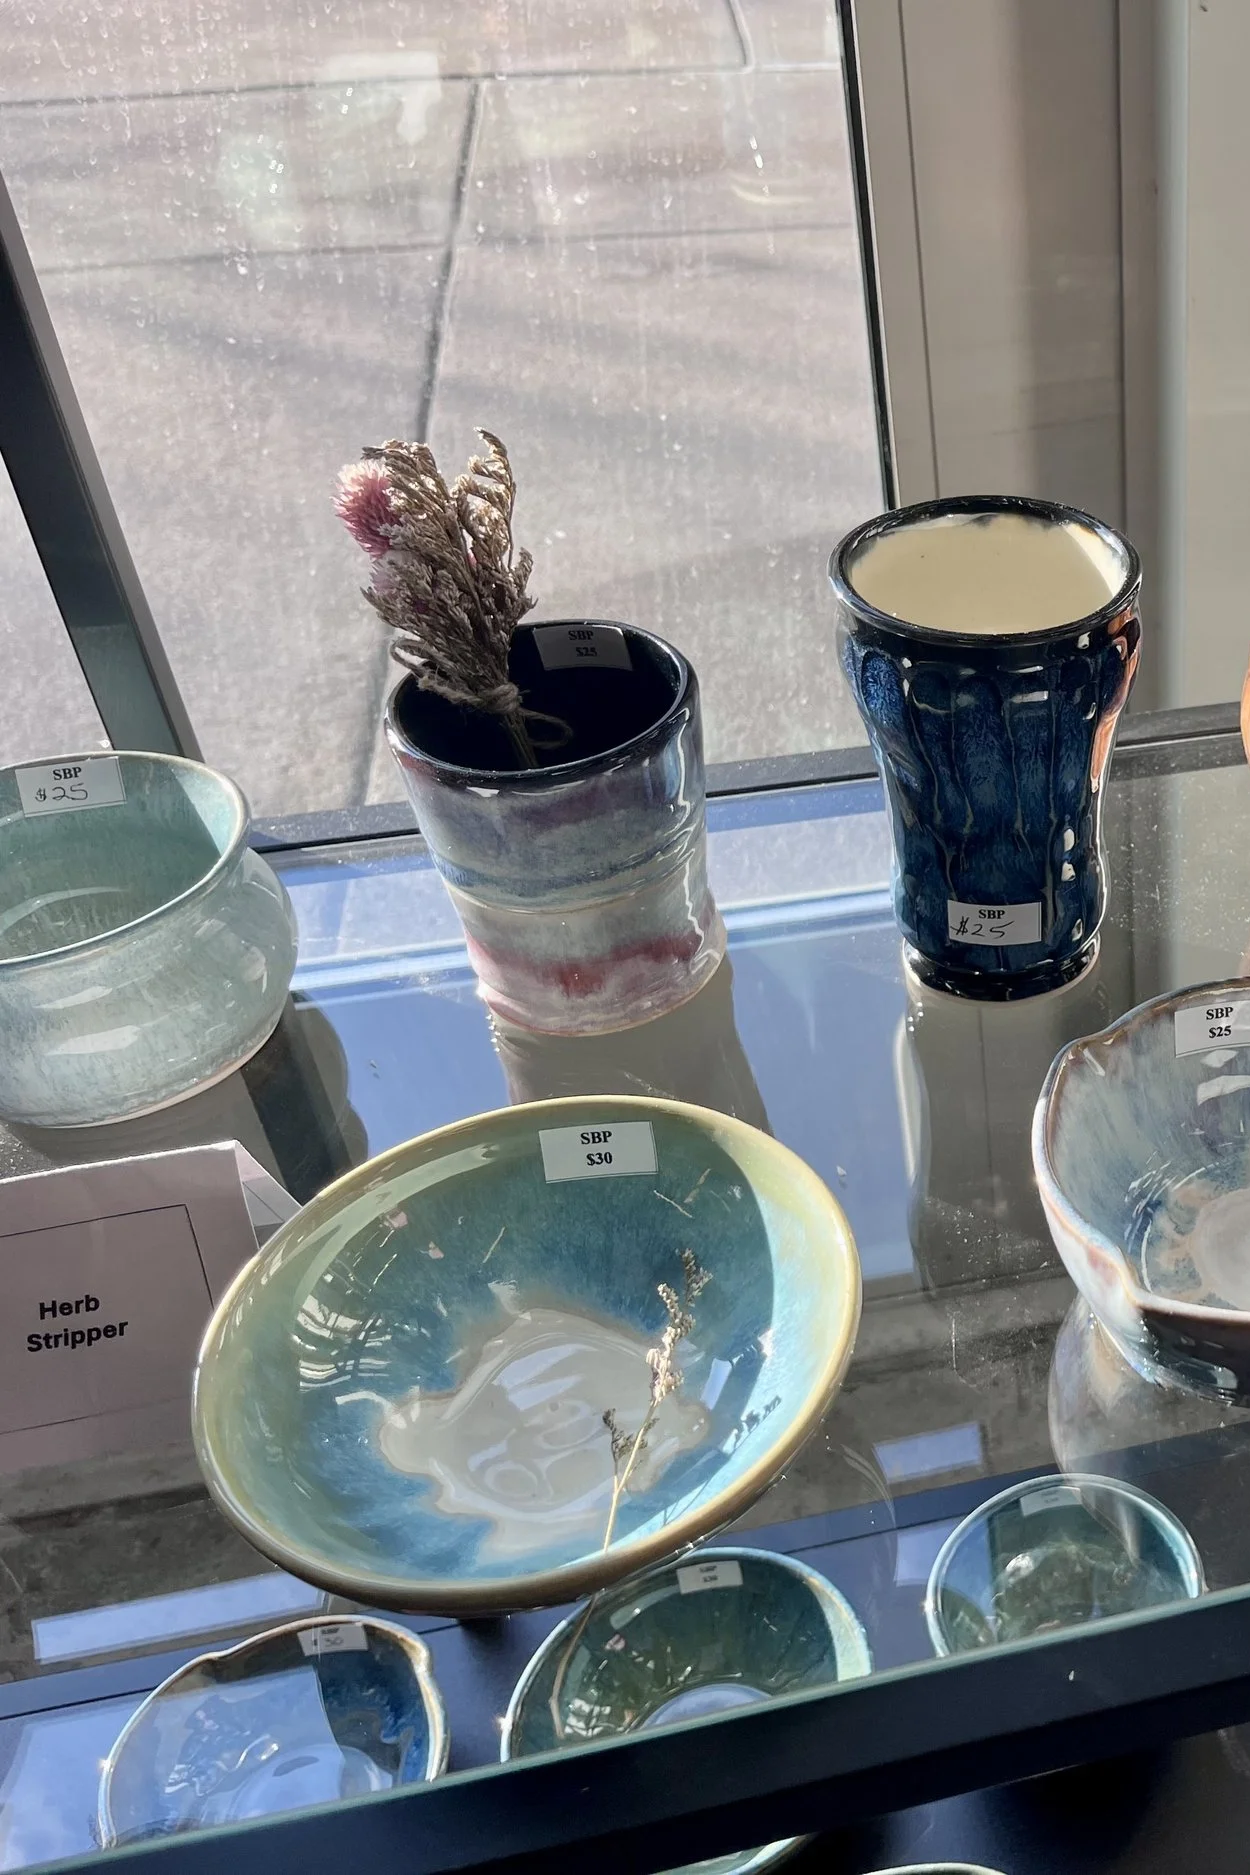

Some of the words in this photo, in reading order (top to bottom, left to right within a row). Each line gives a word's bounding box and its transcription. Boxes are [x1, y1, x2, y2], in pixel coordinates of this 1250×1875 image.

[568, 630, 594, 640] SBP
[575, 647, 597, 657] $25
[53, 766, 82, 780] SBP
[34, 782, 88, 802] $25
[978, 909, 1006, 919] SBP
[950, 915, 1015, 939] $25
[1206, 1006, 1234, 1020] SBP
[1208, 1025, 1232, 1039] $25
[580, 1130, 613, 1145] SBP
[586, 1151, 613, 1167] $30
[39, 1294, 101, 1320] Herb
[27, 1321, 129, 1352] Stripper
